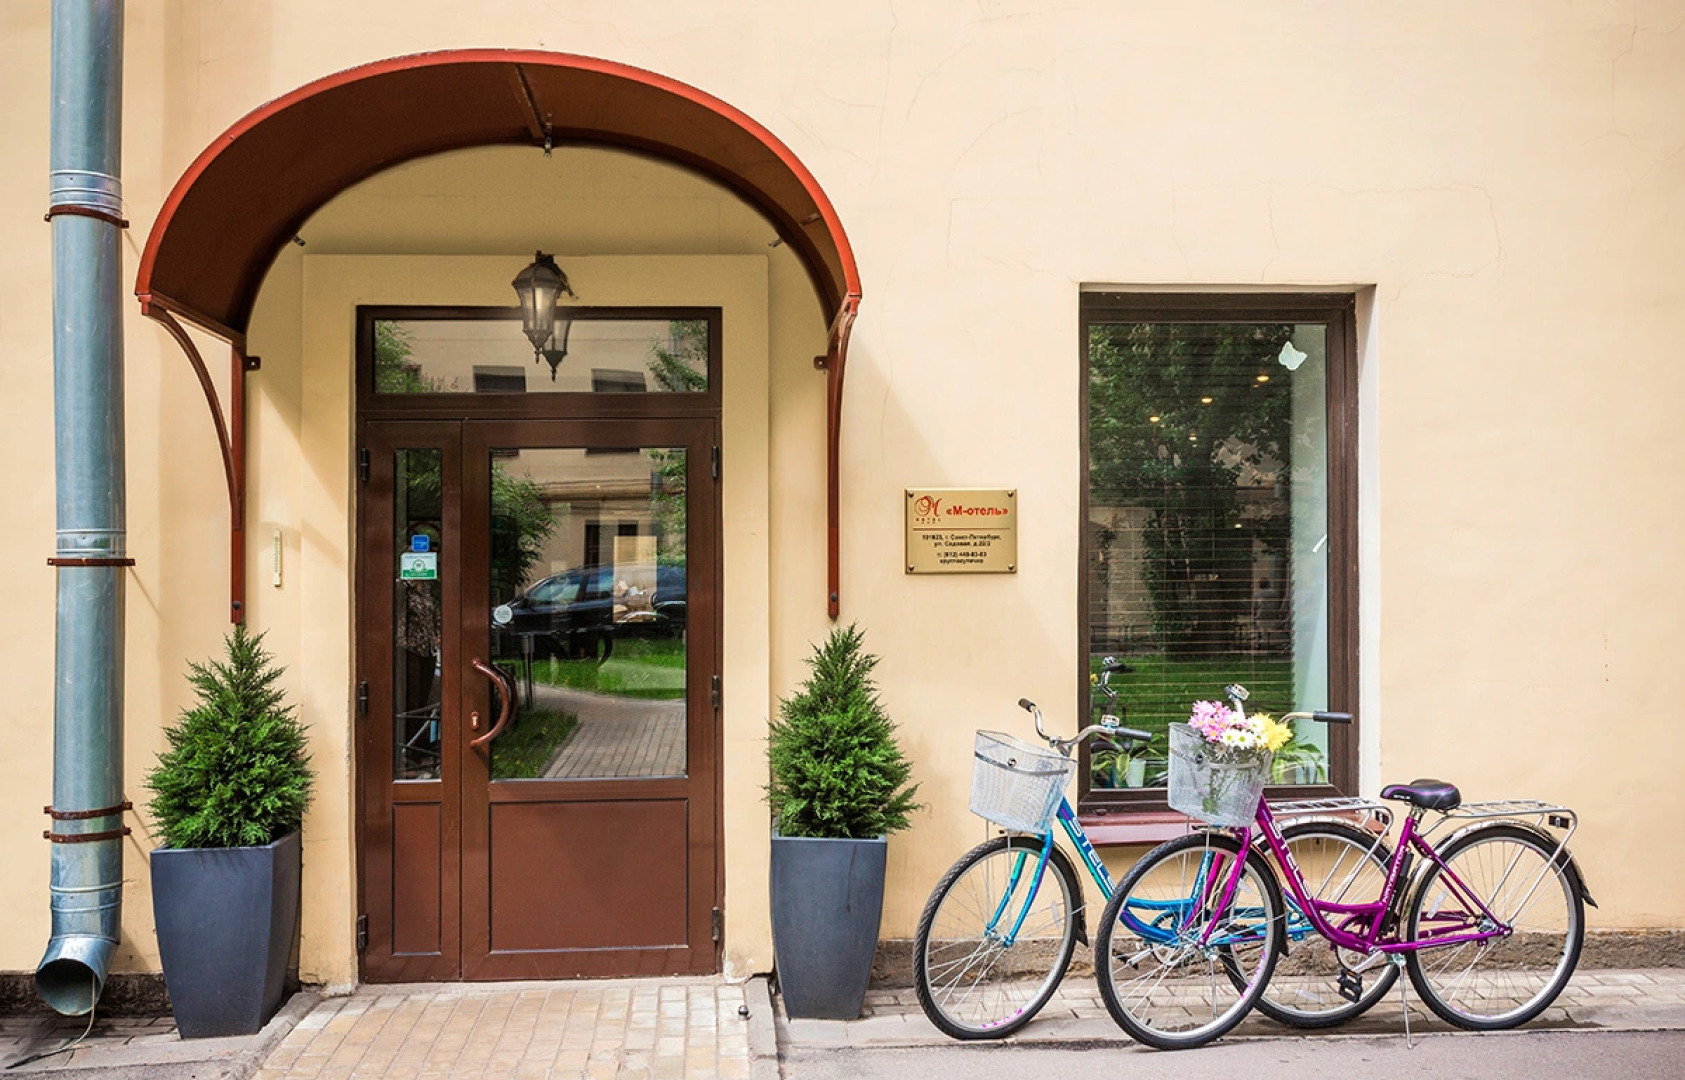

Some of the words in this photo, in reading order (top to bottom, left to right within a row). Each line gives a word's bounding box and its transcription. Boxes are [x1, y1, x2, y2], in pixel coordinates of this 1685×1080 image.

[946, 505, 1008, 516] «М-отель»
[1068, 816, 1116, 895] STELS
[1268, 818, 1313, 900] STELS
